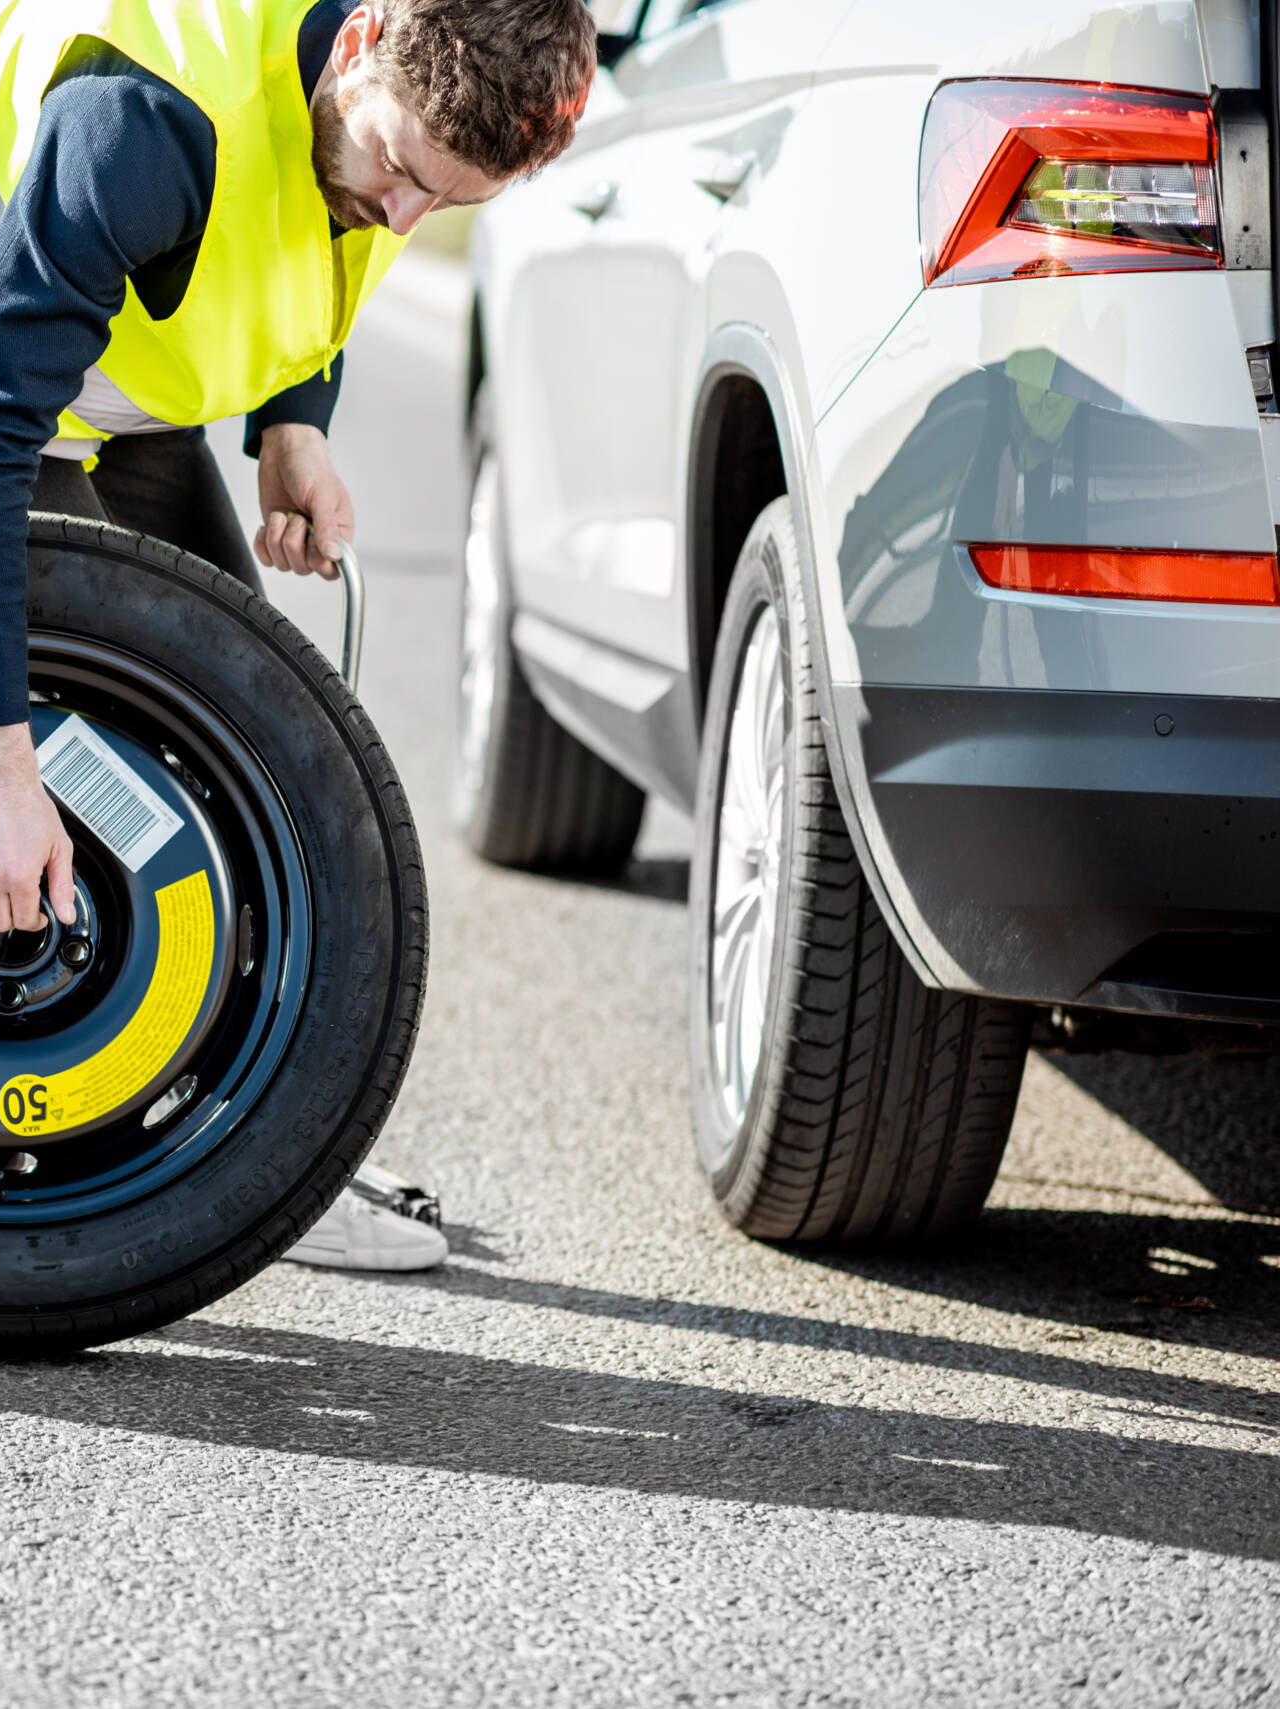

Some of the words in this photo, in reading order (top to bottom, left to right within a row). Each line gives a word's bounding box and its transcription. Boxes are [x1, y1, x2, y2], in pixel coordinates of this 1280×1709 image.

[18, 1077, 33, 1086] mph
[4, 1084, 47, 1124] 50
[22, 1125, 40, 1133] MAX
